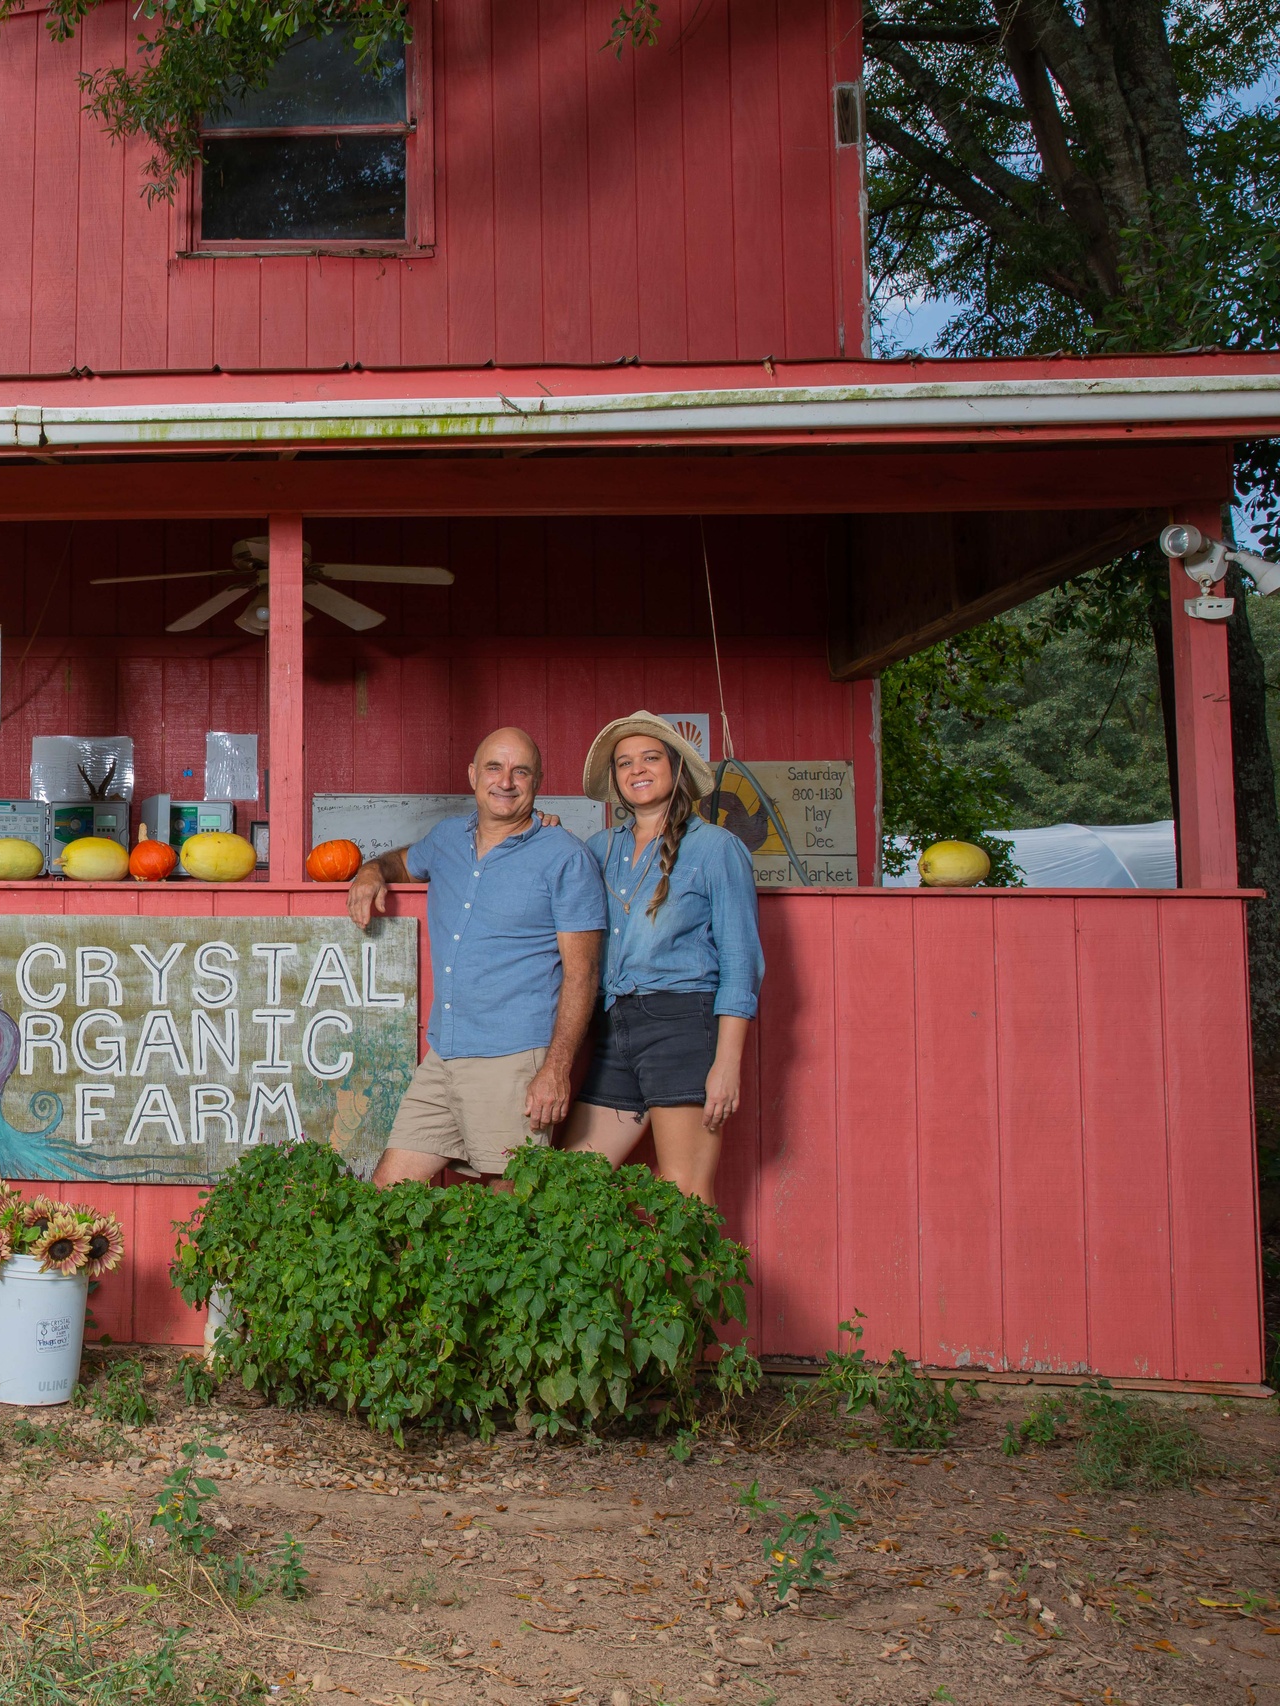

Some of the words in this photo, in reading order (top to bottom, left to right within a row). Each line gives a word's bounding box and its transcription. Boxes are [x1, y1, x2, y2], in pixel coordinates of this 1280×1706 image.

[788, 767, 846, 786] Saturday
[805, 805, 831, 828] May
[789, 861, 853, 882] Market
[16, 942, 404, 1009] CRYSTAL
[75, 1082, 303, 1146] FARM
[38, 1379, 68, 1392] ULINE
